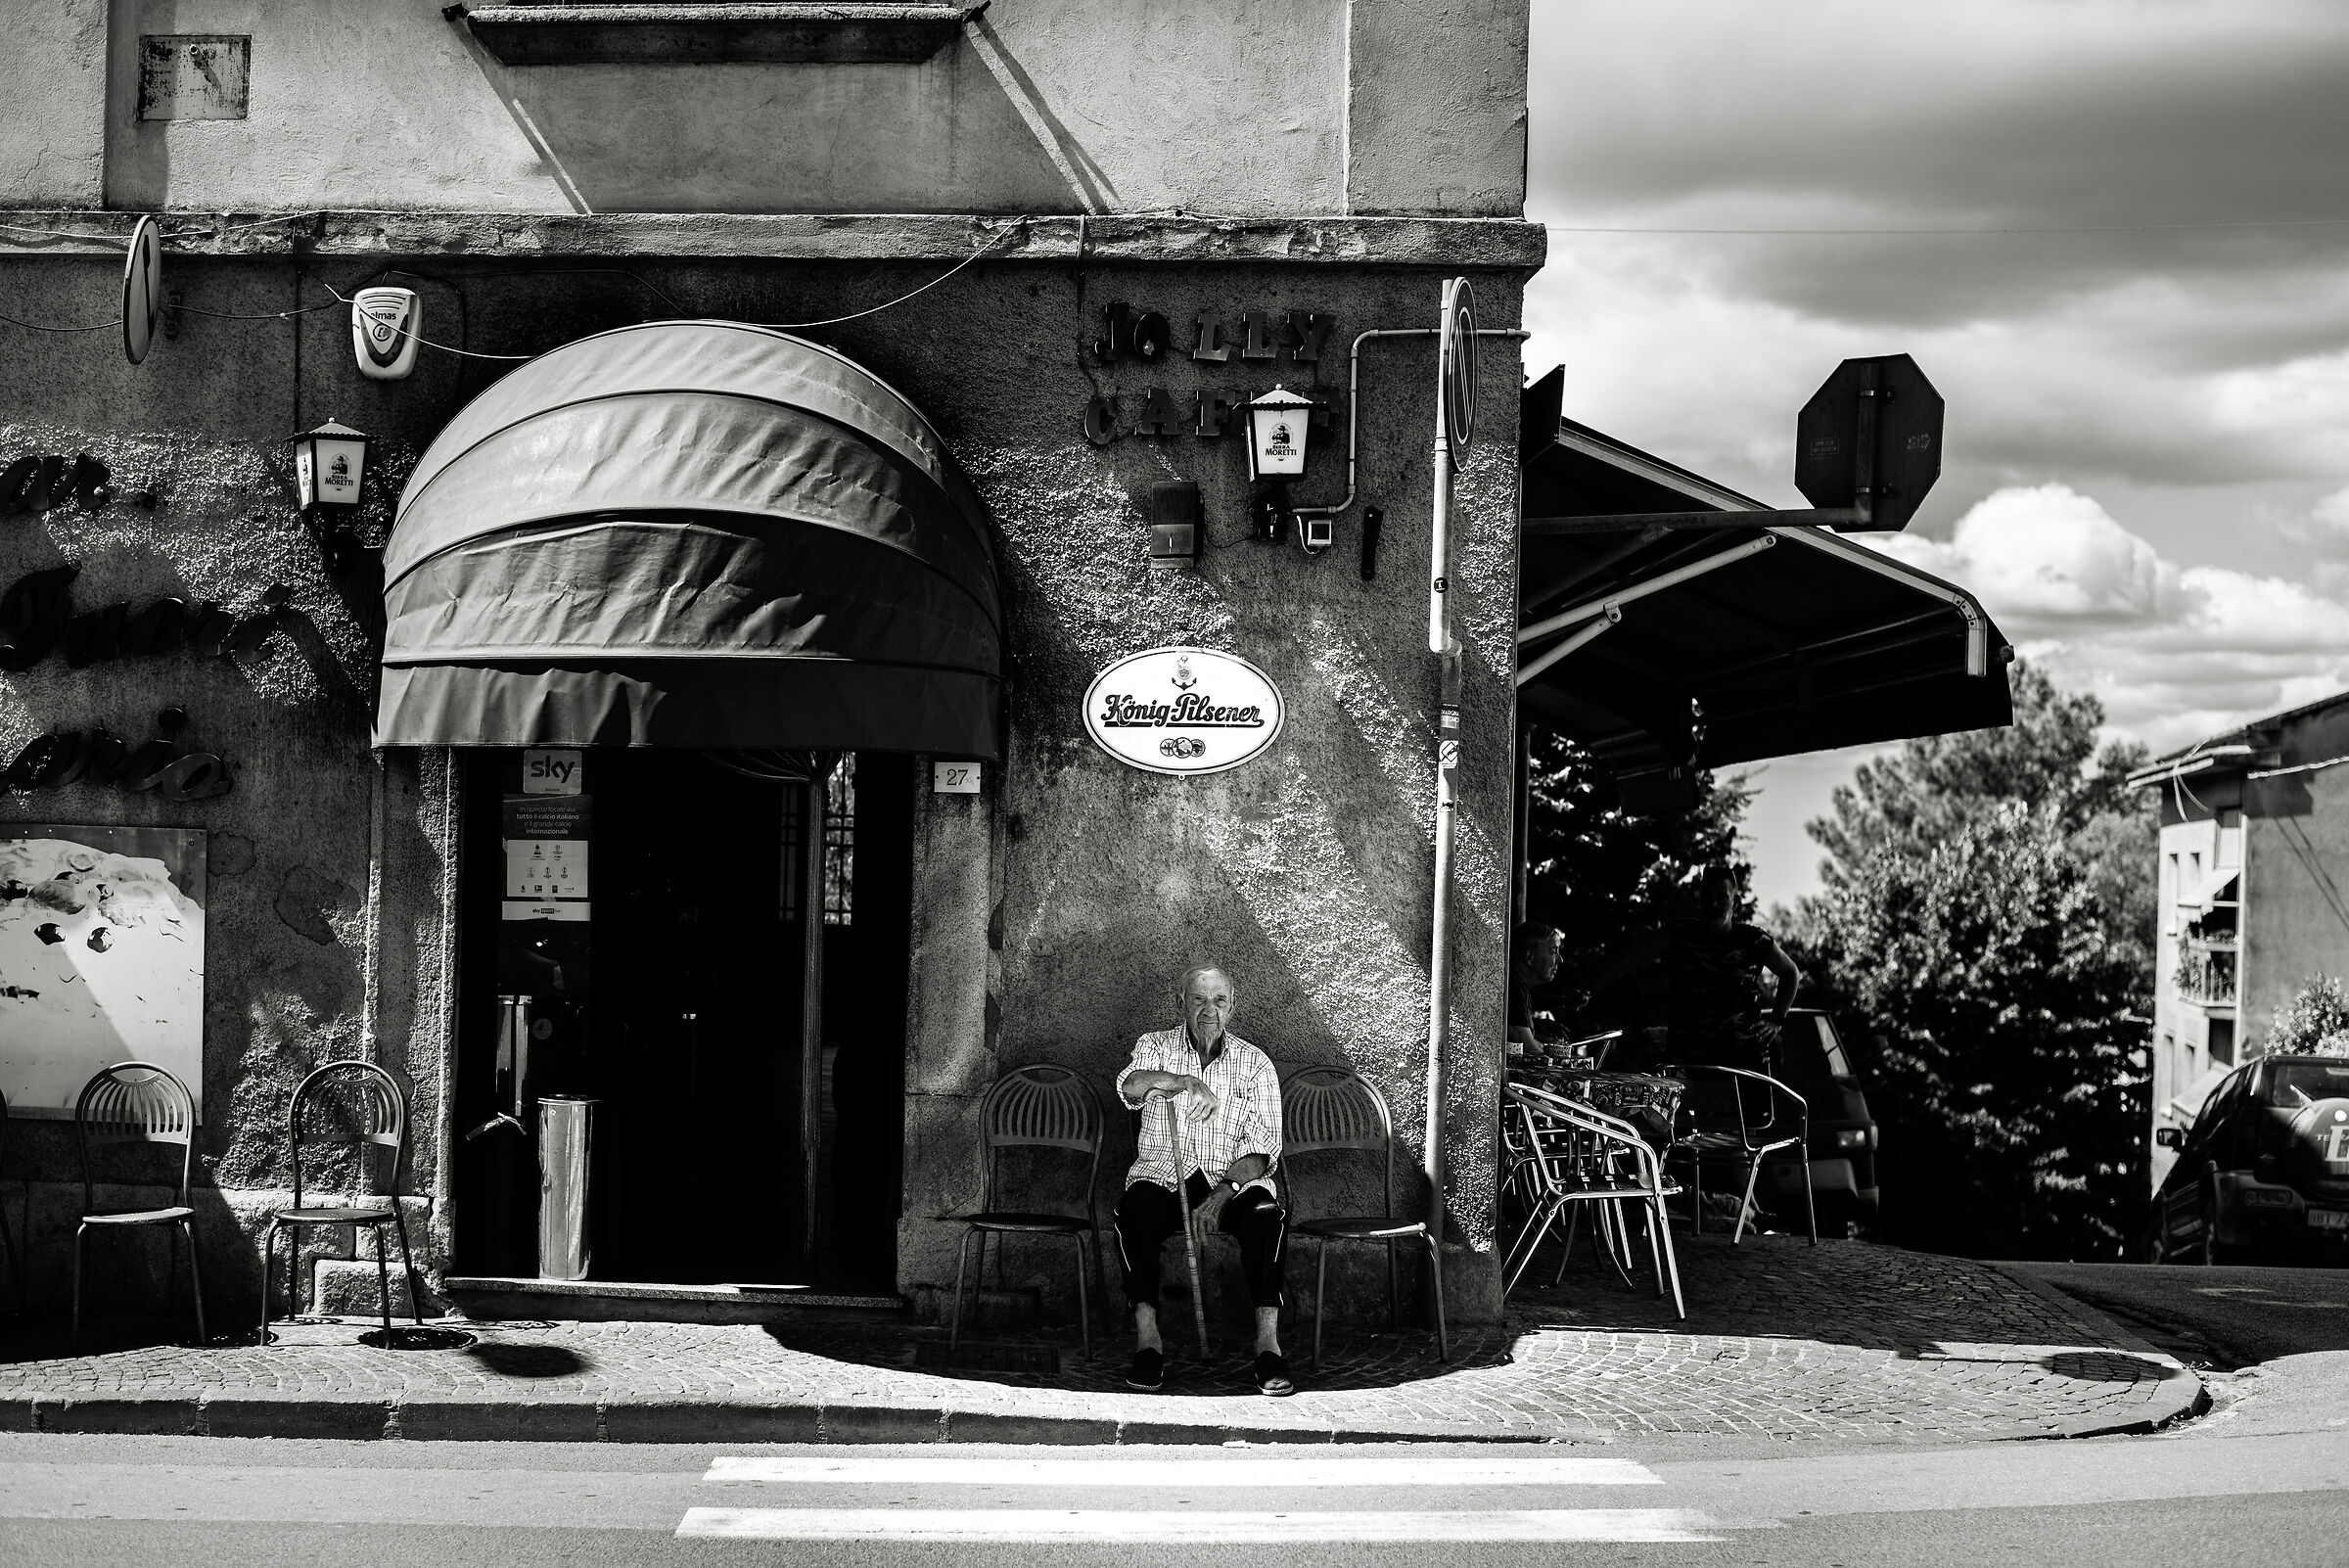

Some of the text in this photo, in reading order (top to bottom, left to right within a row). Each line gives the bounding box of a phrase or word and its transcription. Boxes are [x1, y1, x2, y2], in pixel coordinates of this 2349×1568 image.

[324, 478, 353, 486] MORETTI
[1101, 693, 1265, 727] König-Pilsener
[530, 755, 576, 784] sky
[946, 768, 969, 786] 27
